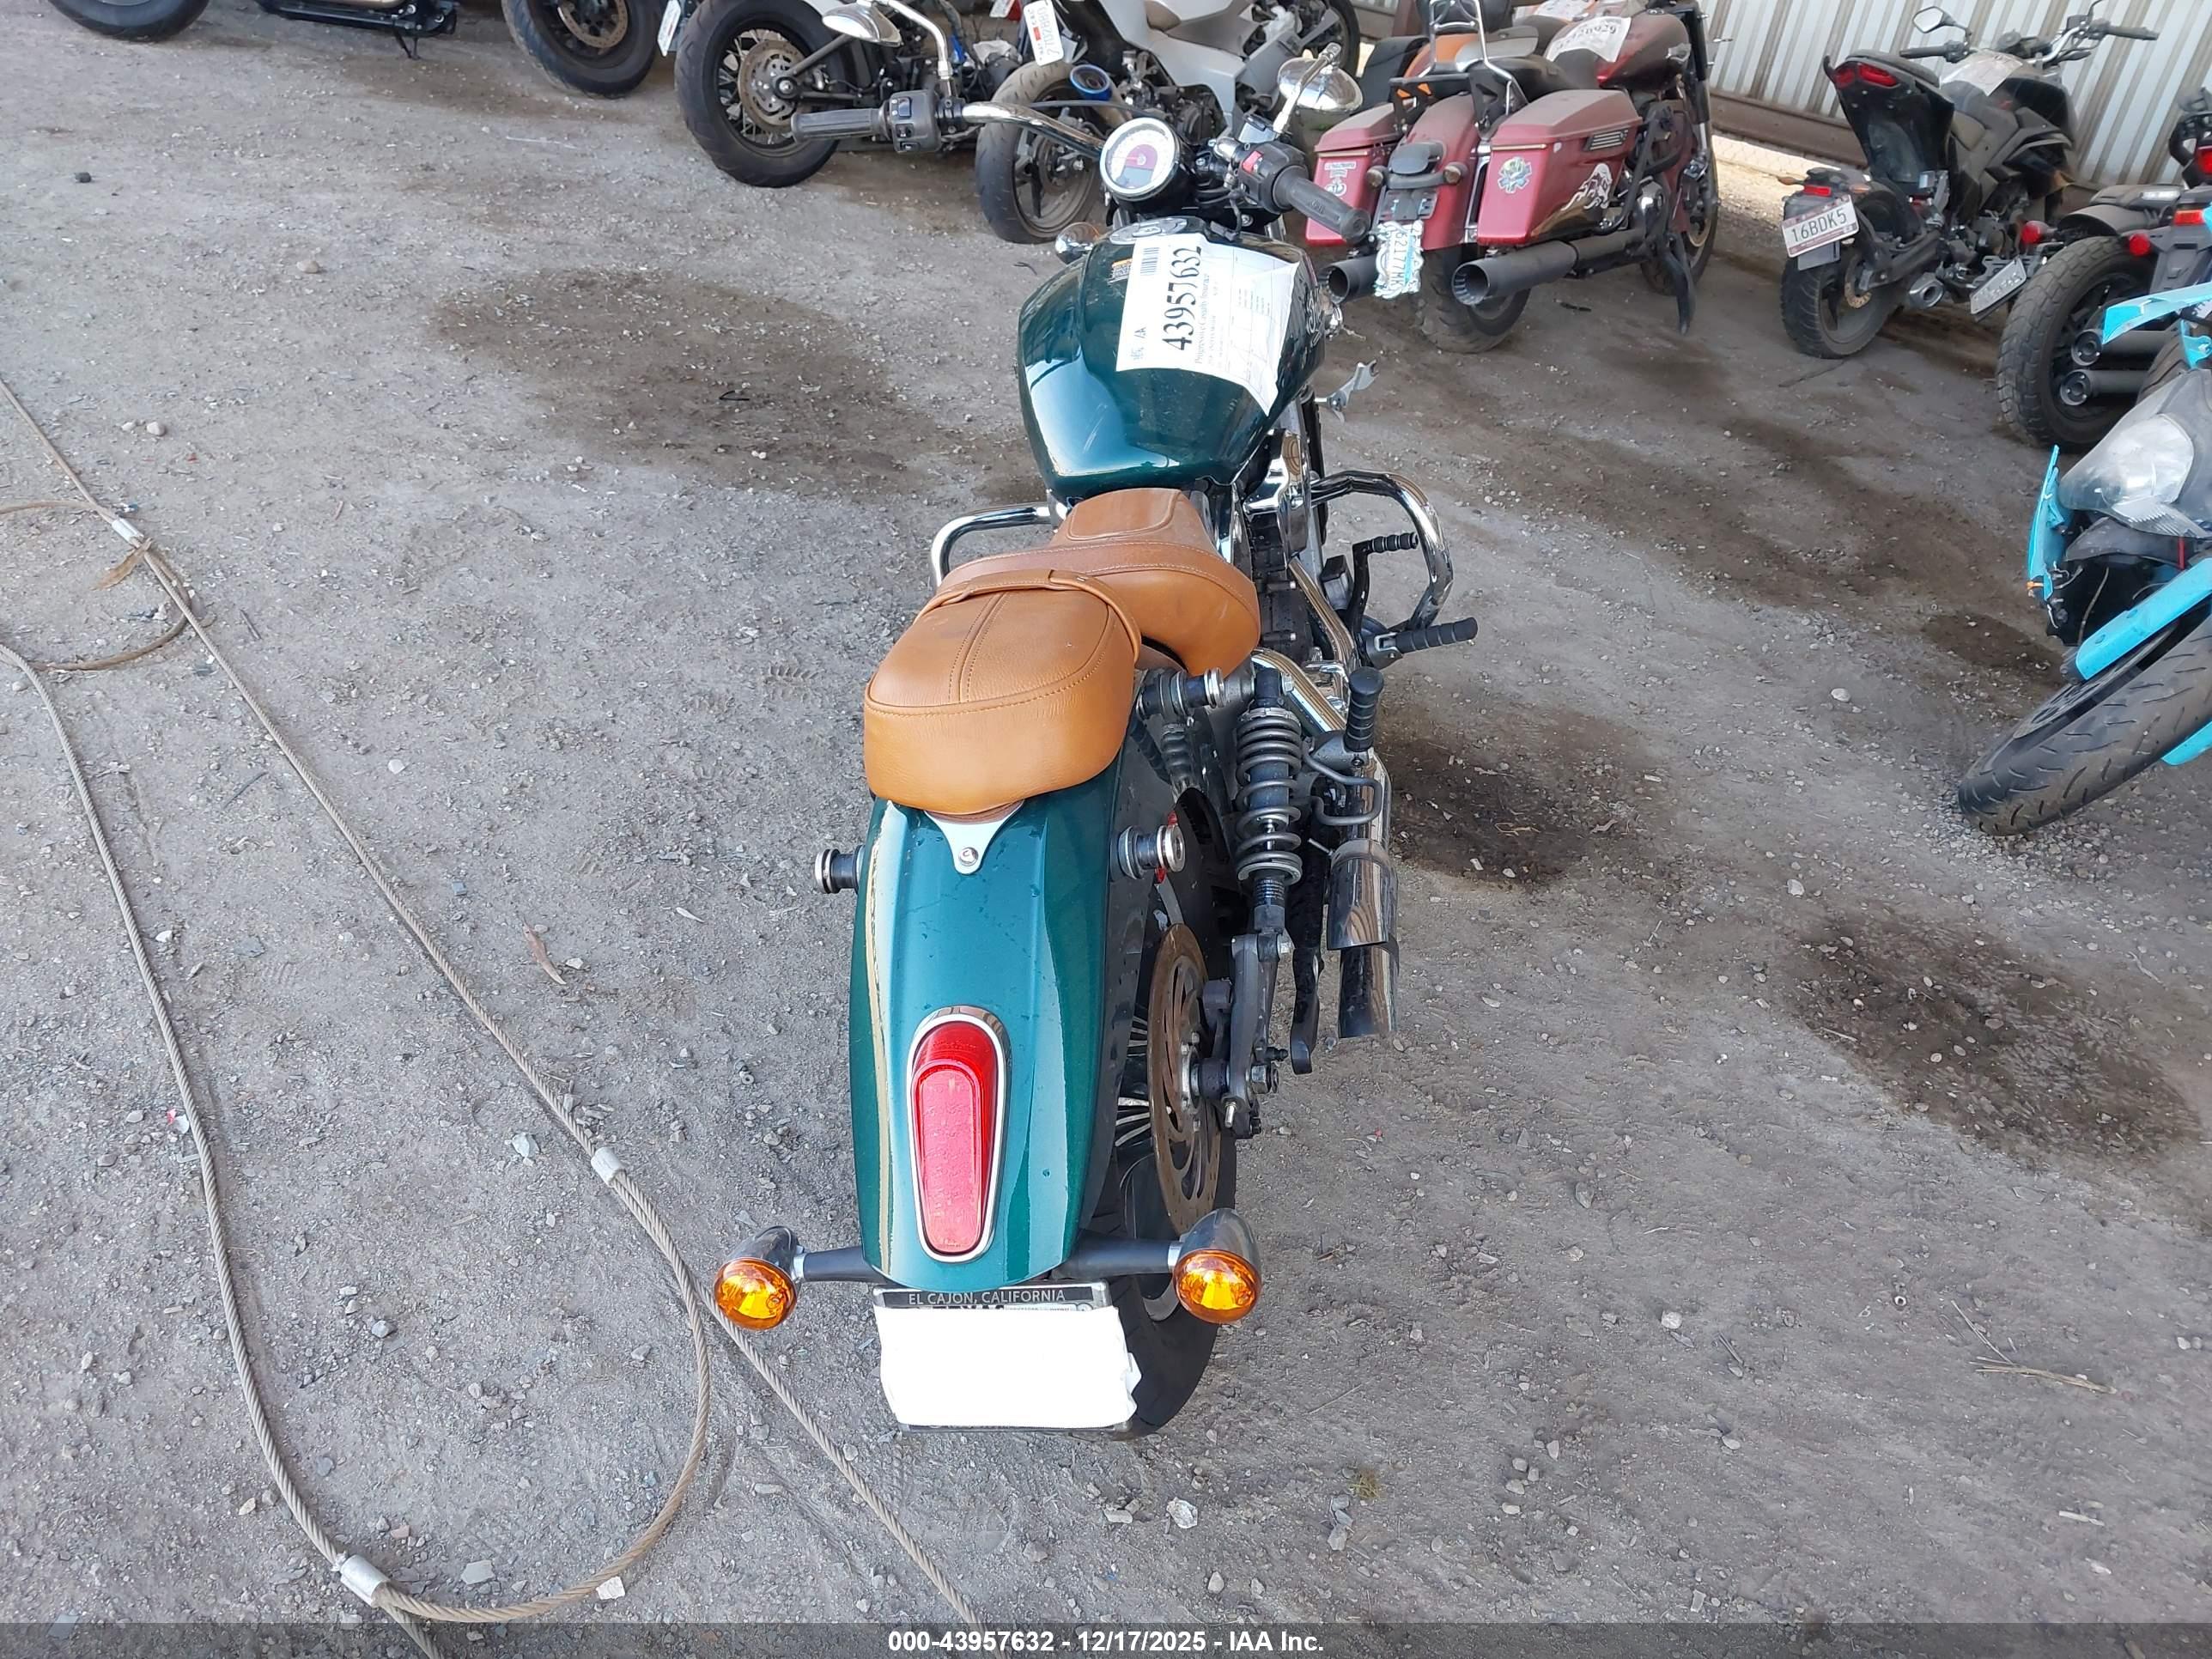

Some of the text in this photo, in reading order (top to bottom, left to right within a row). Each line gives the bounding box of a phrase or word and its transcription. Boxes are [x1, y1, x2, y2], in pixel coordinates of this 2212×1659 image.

[1792, 208, 1847, 242] 16BDK5
[1162, 246, 1202, 350] 43957632
[908, 1289, 1066, 1305] EL CAJON, CALIFORNIA
